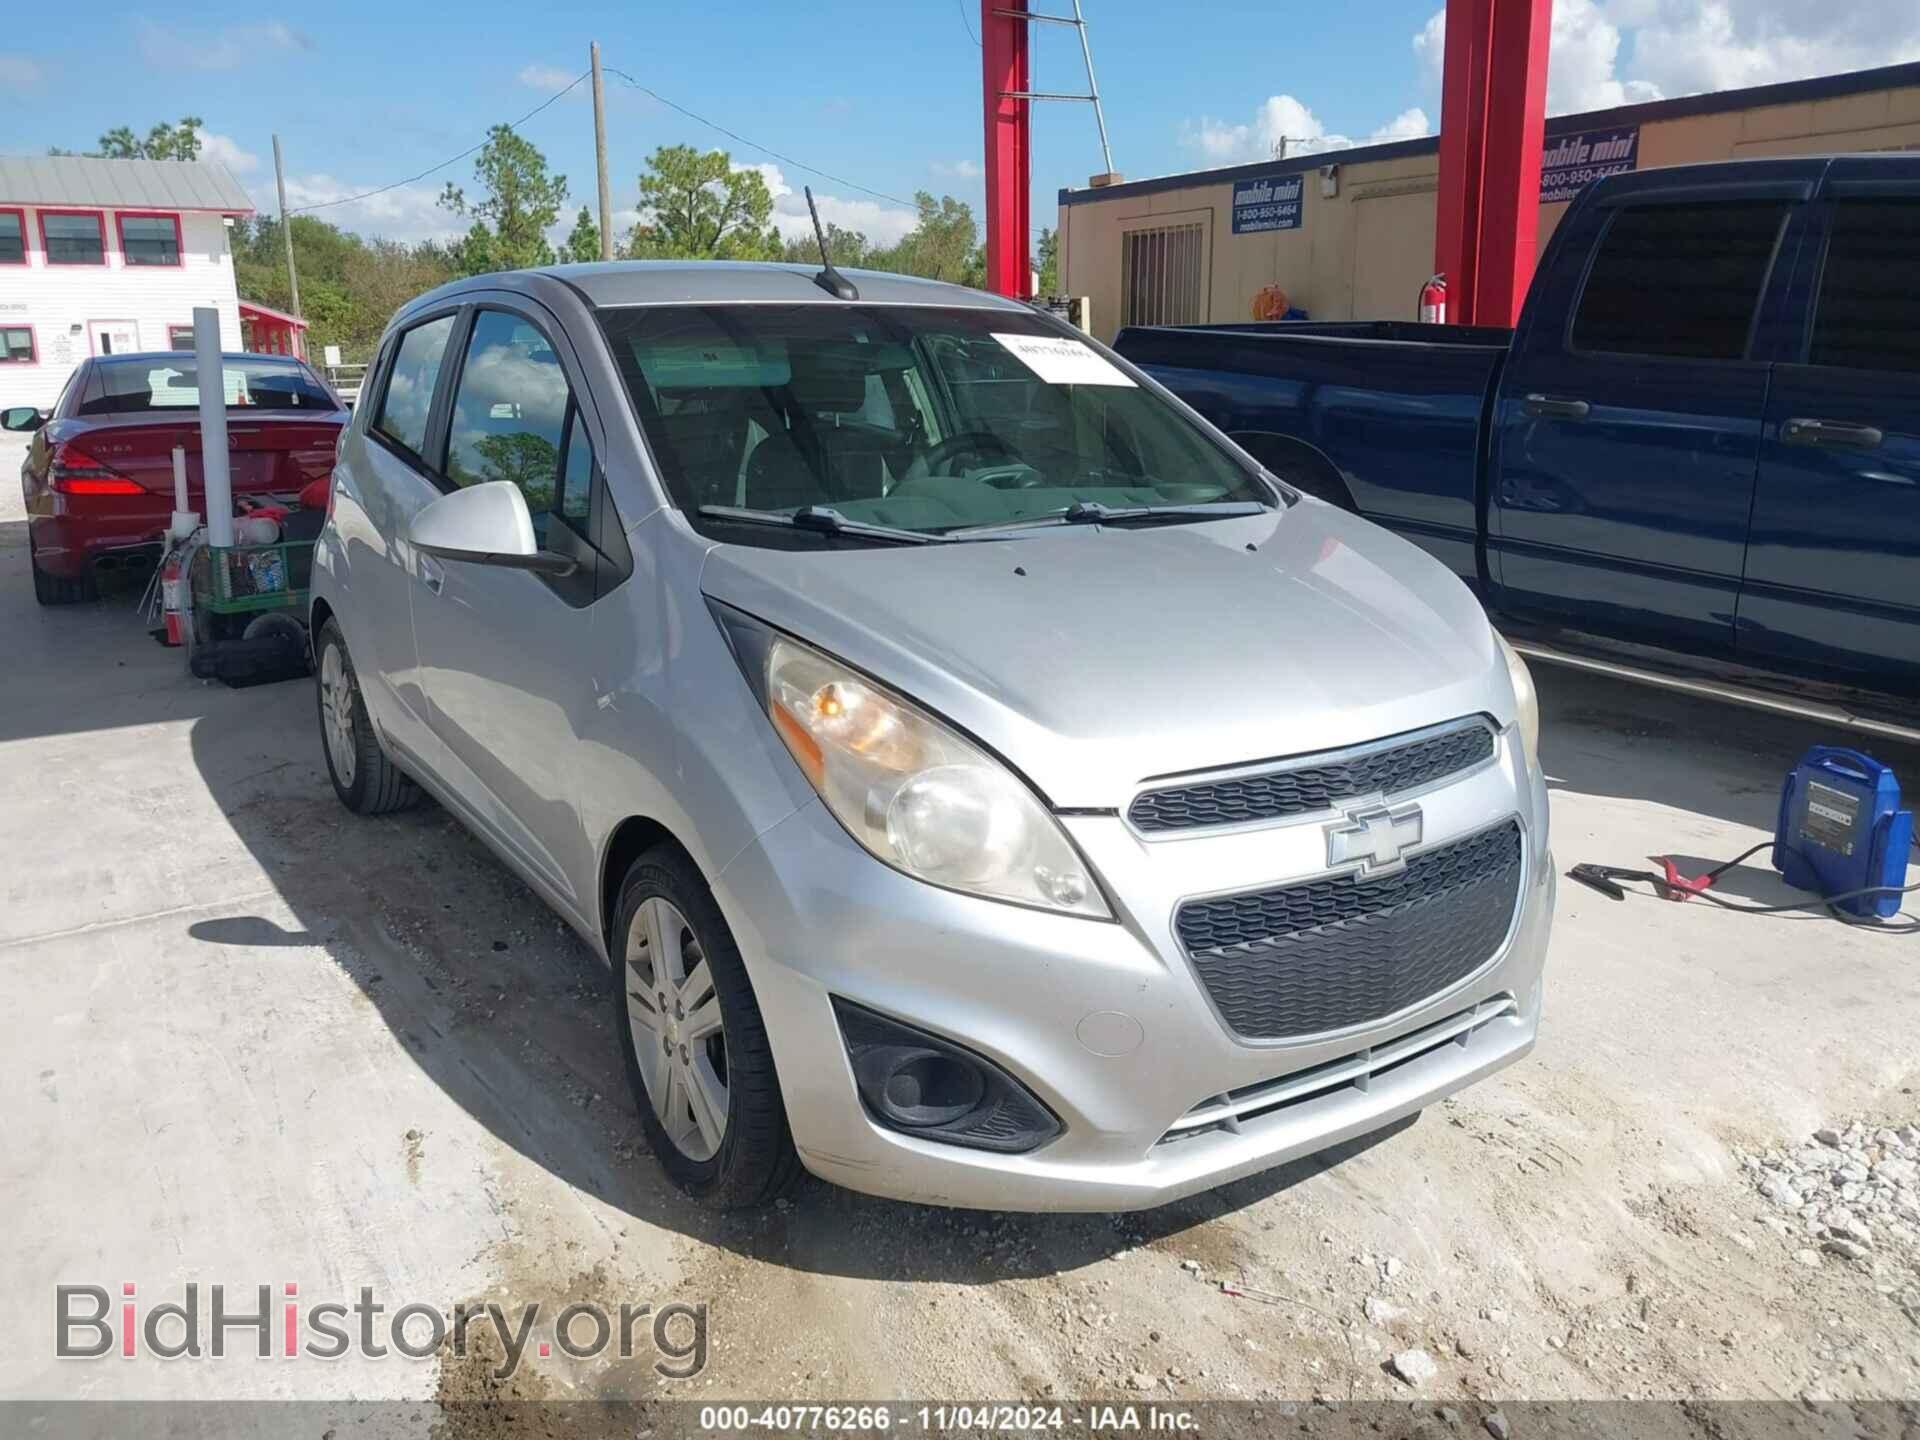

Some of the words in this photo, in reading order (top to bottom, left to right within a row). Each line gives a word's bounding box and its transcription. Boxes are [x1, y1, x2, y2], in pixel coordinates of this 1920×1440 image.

[1590, 133, 1636, 161] mini
[1235, 180, 1273, 206] mobile
[1273, 179, 1302, 201] mini
